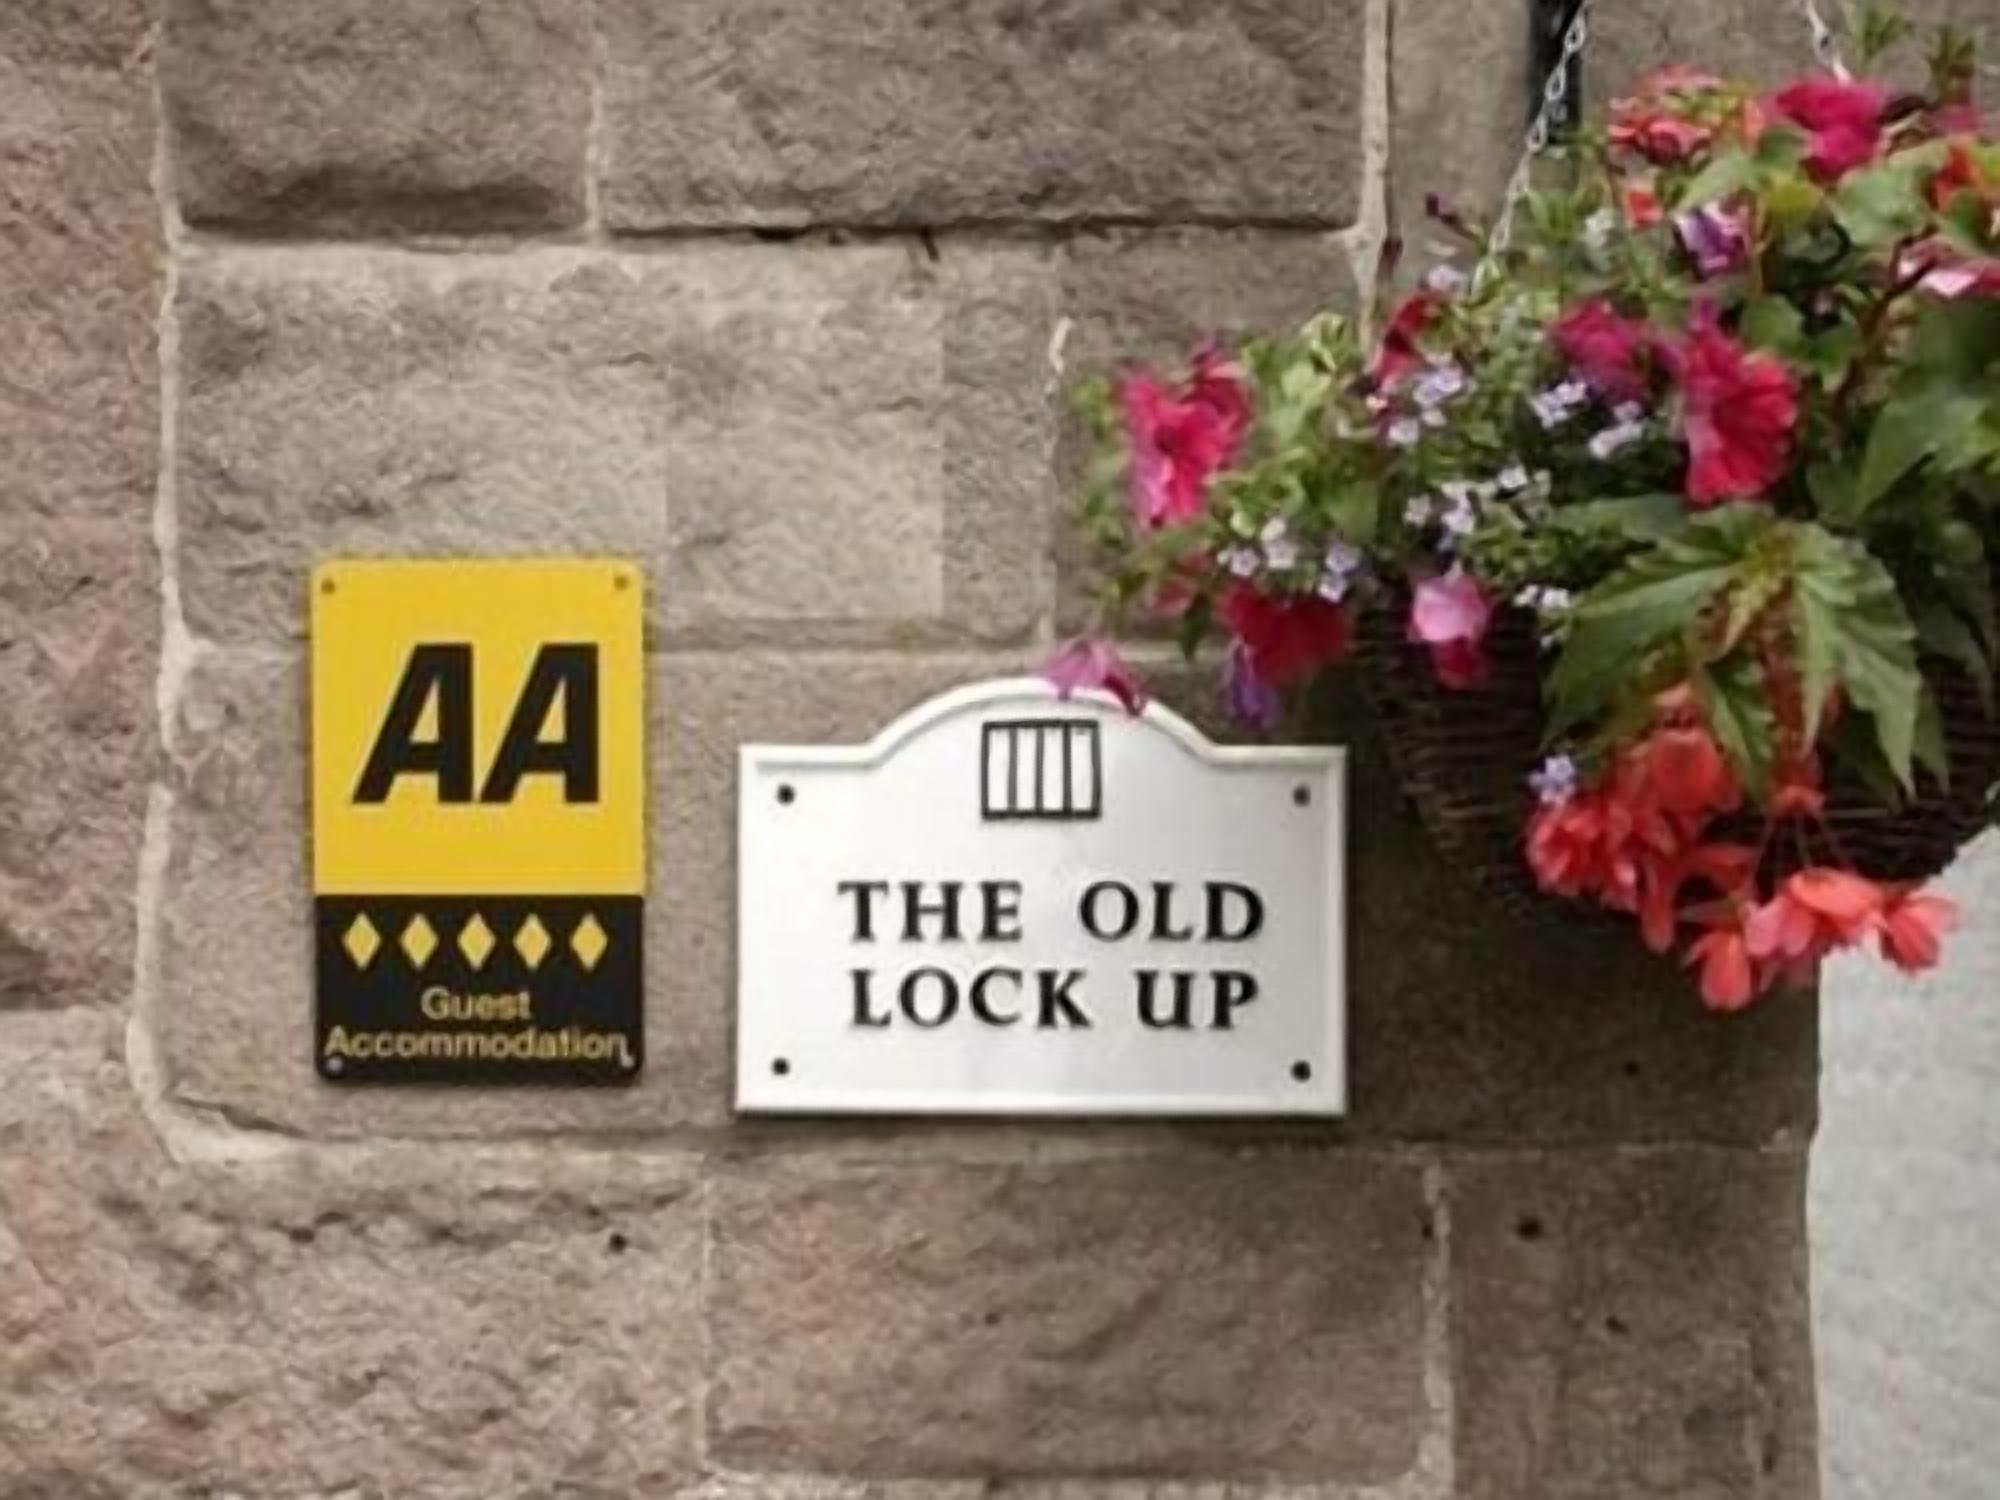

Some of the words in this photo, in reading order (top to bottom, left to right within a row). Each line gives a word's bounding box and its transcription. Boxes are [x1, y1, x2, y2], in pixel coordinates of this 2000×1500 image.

[352, 642, 600, 805] AA
[838, 881, 1022, 942] THE
[1079, 880, 1265, 942] OLD
[420, 986, 531, 1020] Guest
[850, 967, 1092, 1029] LOCK
[1134, 969, 1260, 1030] UP
[325, 1025, 628, 1060] Accommodation
